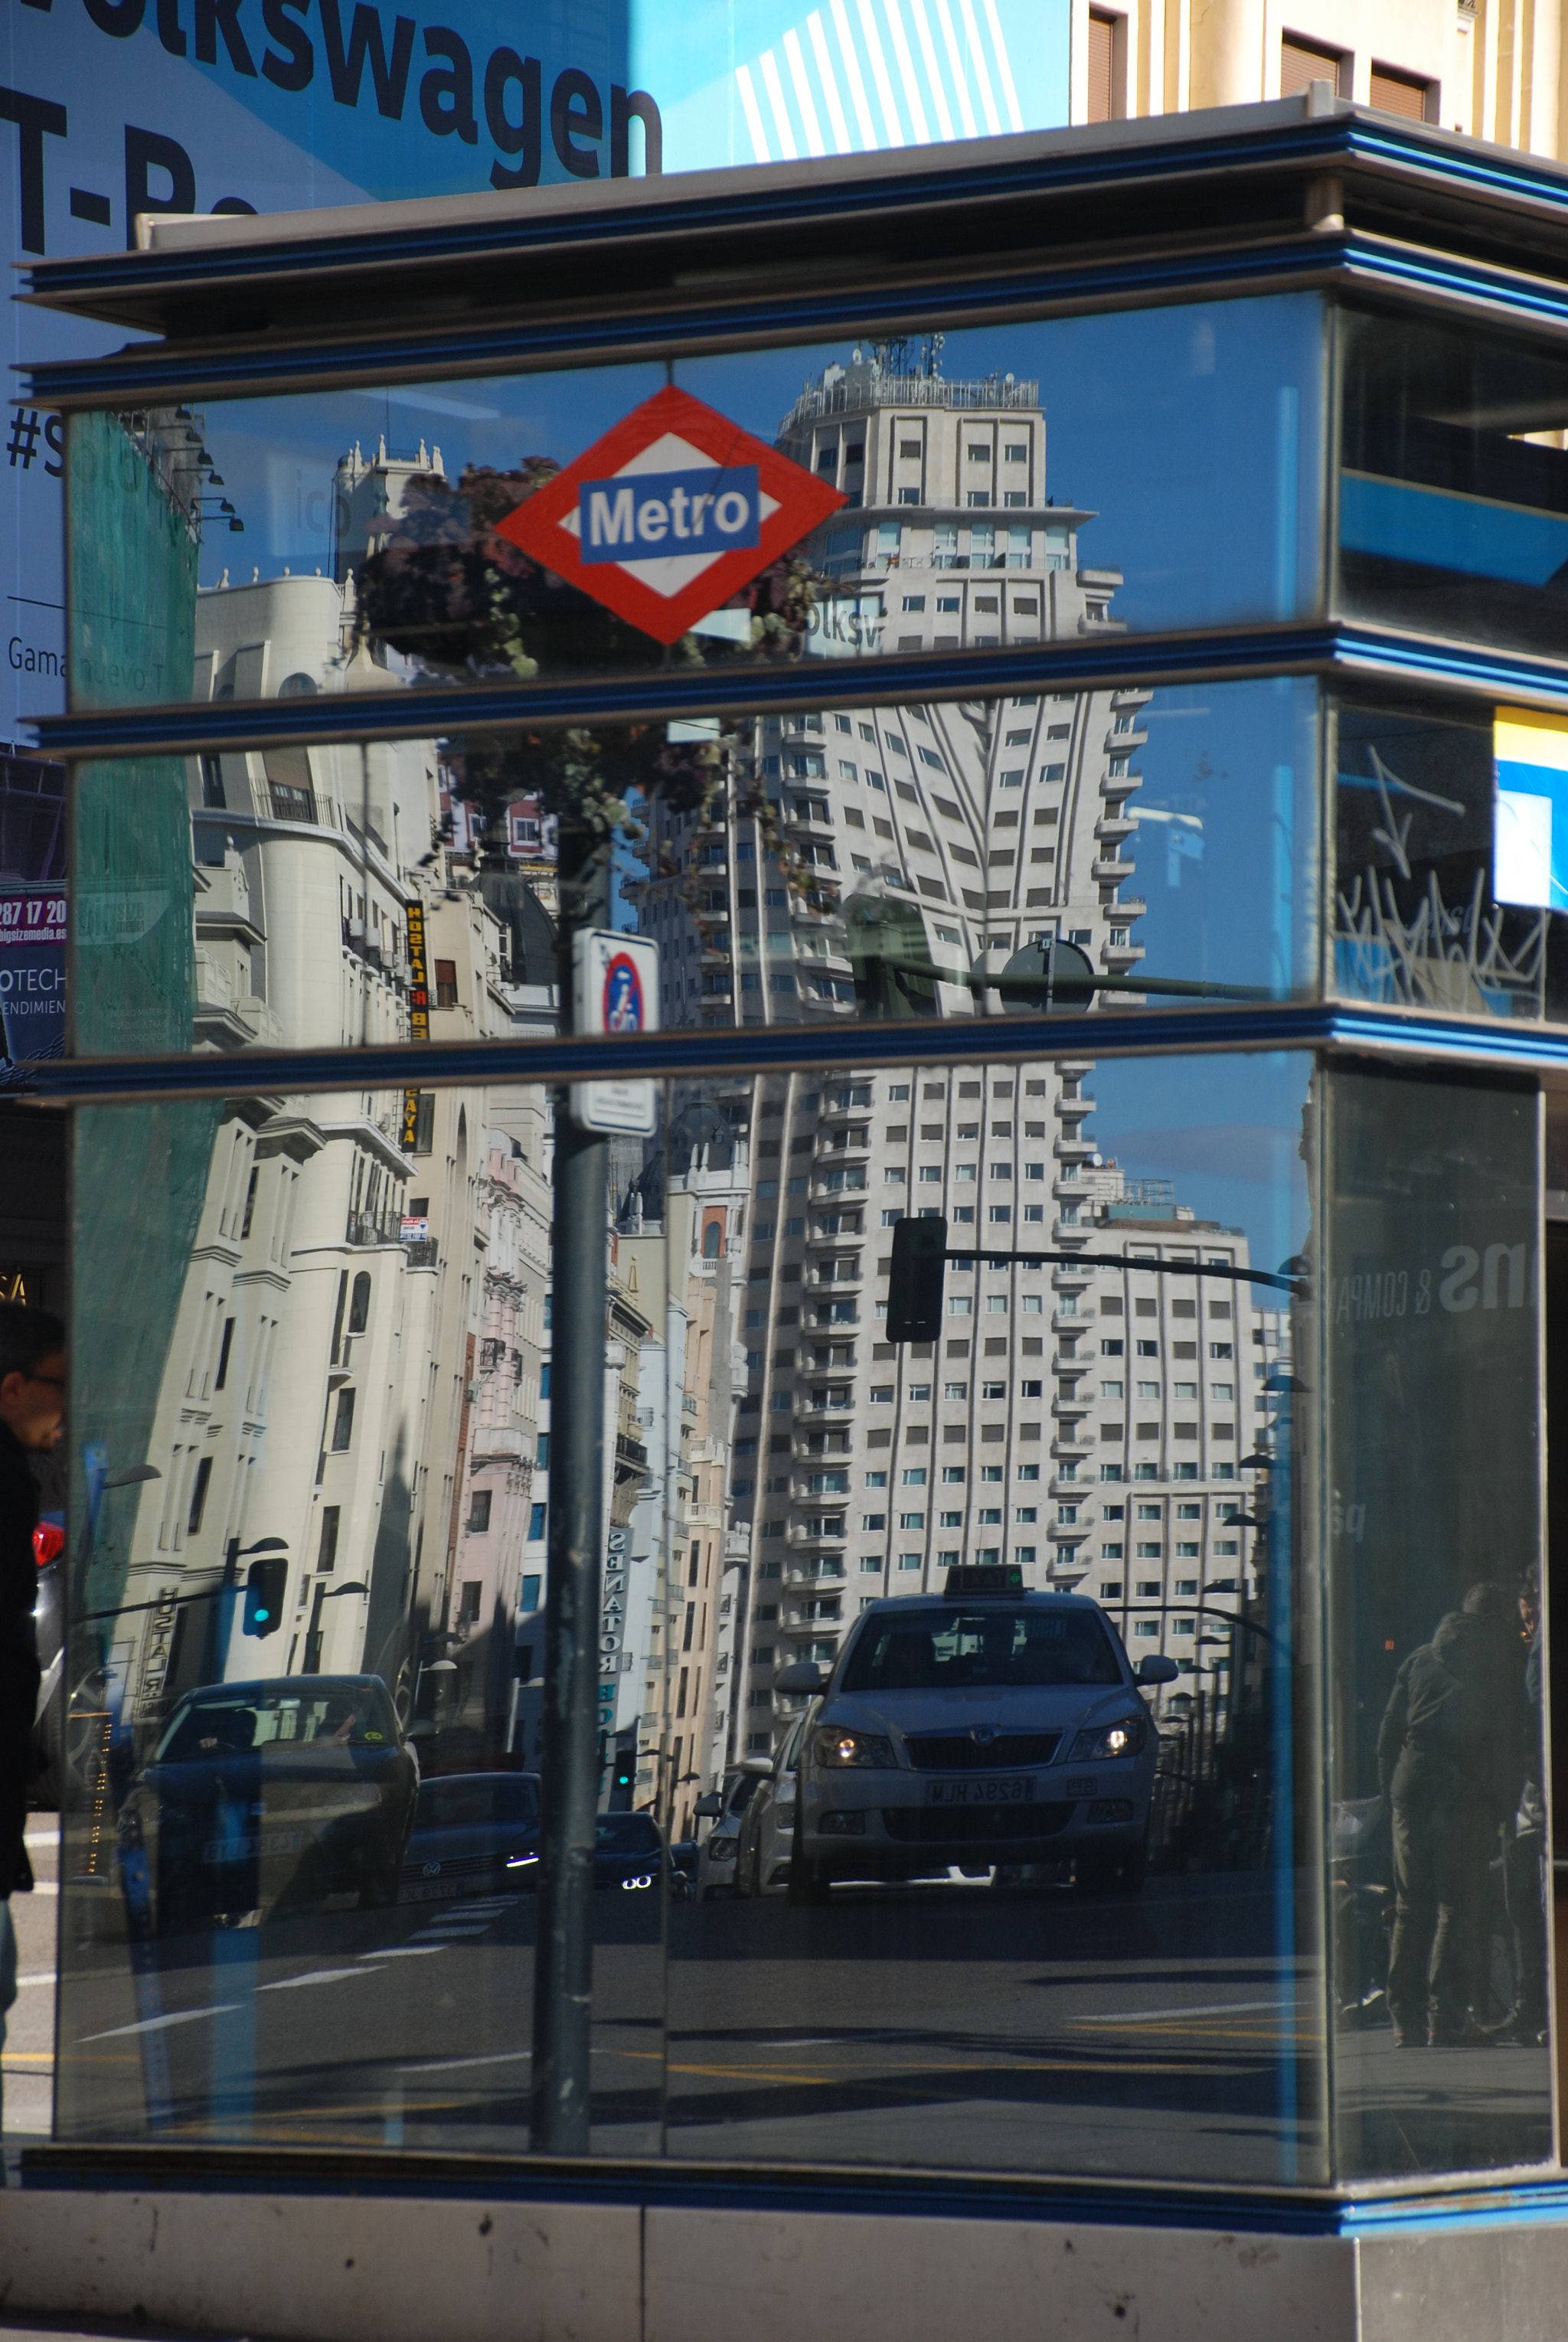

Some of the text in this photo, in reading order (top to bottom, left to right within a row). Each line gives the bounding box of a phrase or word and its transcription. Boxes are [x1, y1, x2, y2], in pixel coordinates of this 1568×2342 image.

[20, 0, 663, 190] kswagen
[0, 86, 259, 255] T-R
[589, 485, 750, 546] Metro
[26, 901, 43, 925] 17
[47, 900, 67, 923] 20
